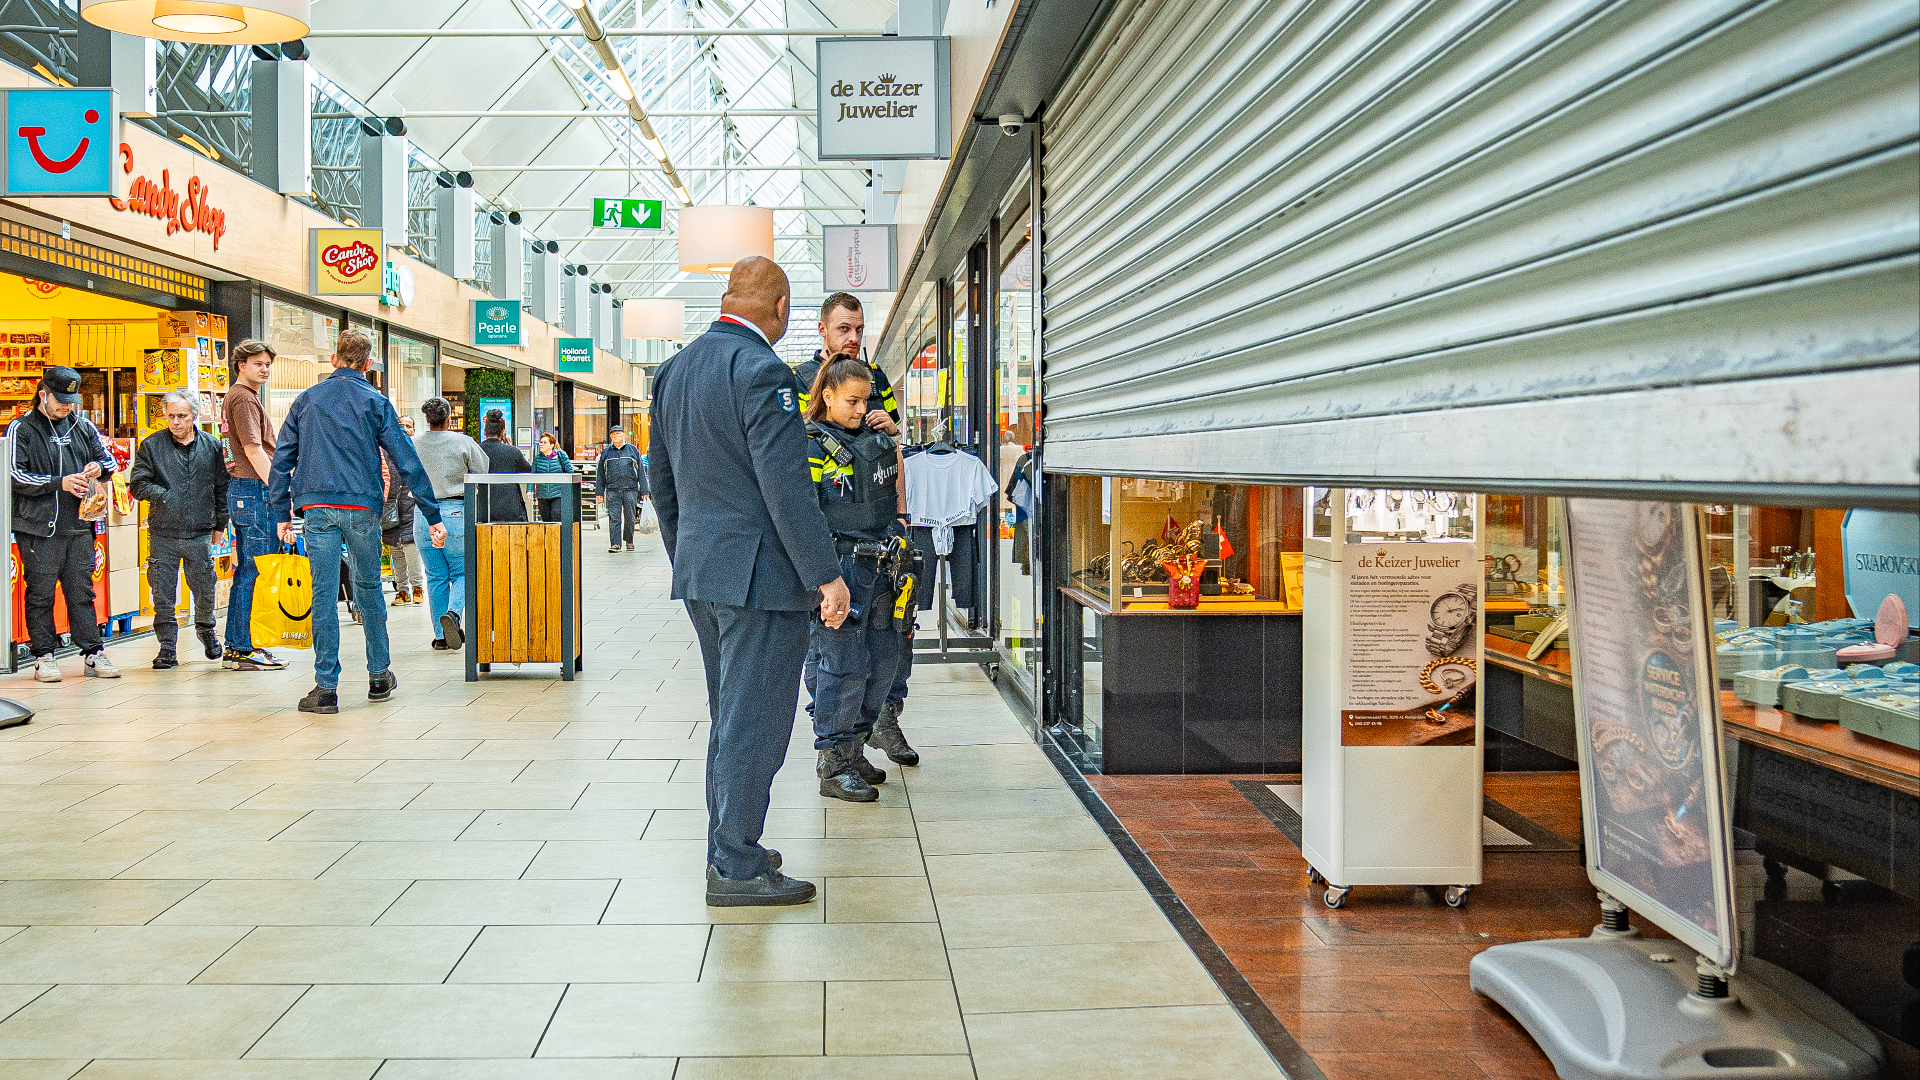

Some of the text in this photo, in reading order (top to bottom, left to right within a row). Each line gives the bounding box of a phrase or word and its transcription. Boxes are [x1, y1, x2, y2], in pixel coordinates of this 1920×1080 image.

[831, 80, 923, 97] de Keizer
[837, 101, 918, 122] Juwelier
[180, 175, 227, 252] Shop
[324, 244, 369, 264] Candy
[345, 255, 375, 274] Shop
[478, 322, 517, 334] Pearle
[1358, 556, 1461, 570] de Keizer Juwelier
